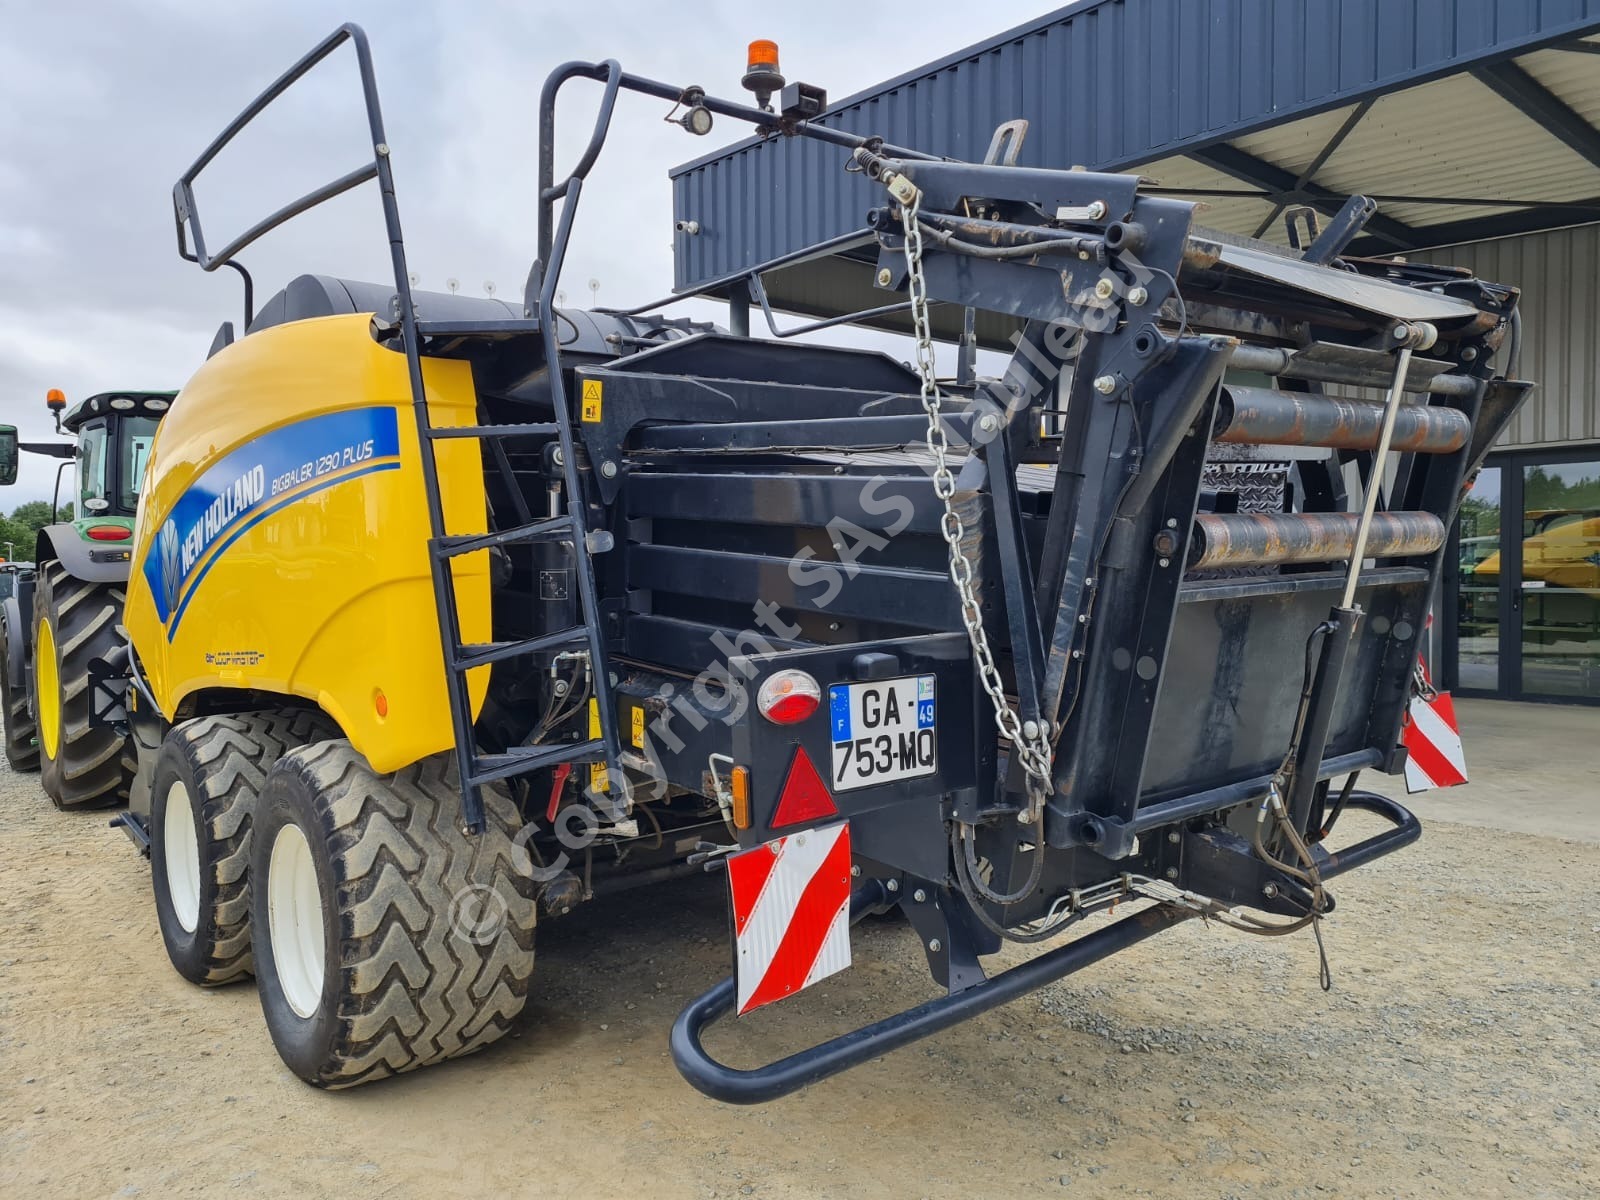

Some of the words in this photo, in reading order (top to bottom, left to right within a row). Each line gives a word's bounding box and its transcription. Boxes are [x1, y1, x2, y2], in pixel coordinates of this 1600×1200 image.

[271, 462, 313, 495] BIGBALER
[315, 451, 340, 476] 1290
[342, 439, 374, 467] PLUS
[181, 516, 204, 577] NEW
[205, 464, 265, 544] HOLLAND
[838, 719, 844, 731] F
[919, 704, 934, 723] 49
[835, 729, 934, 783] 753-MQ
